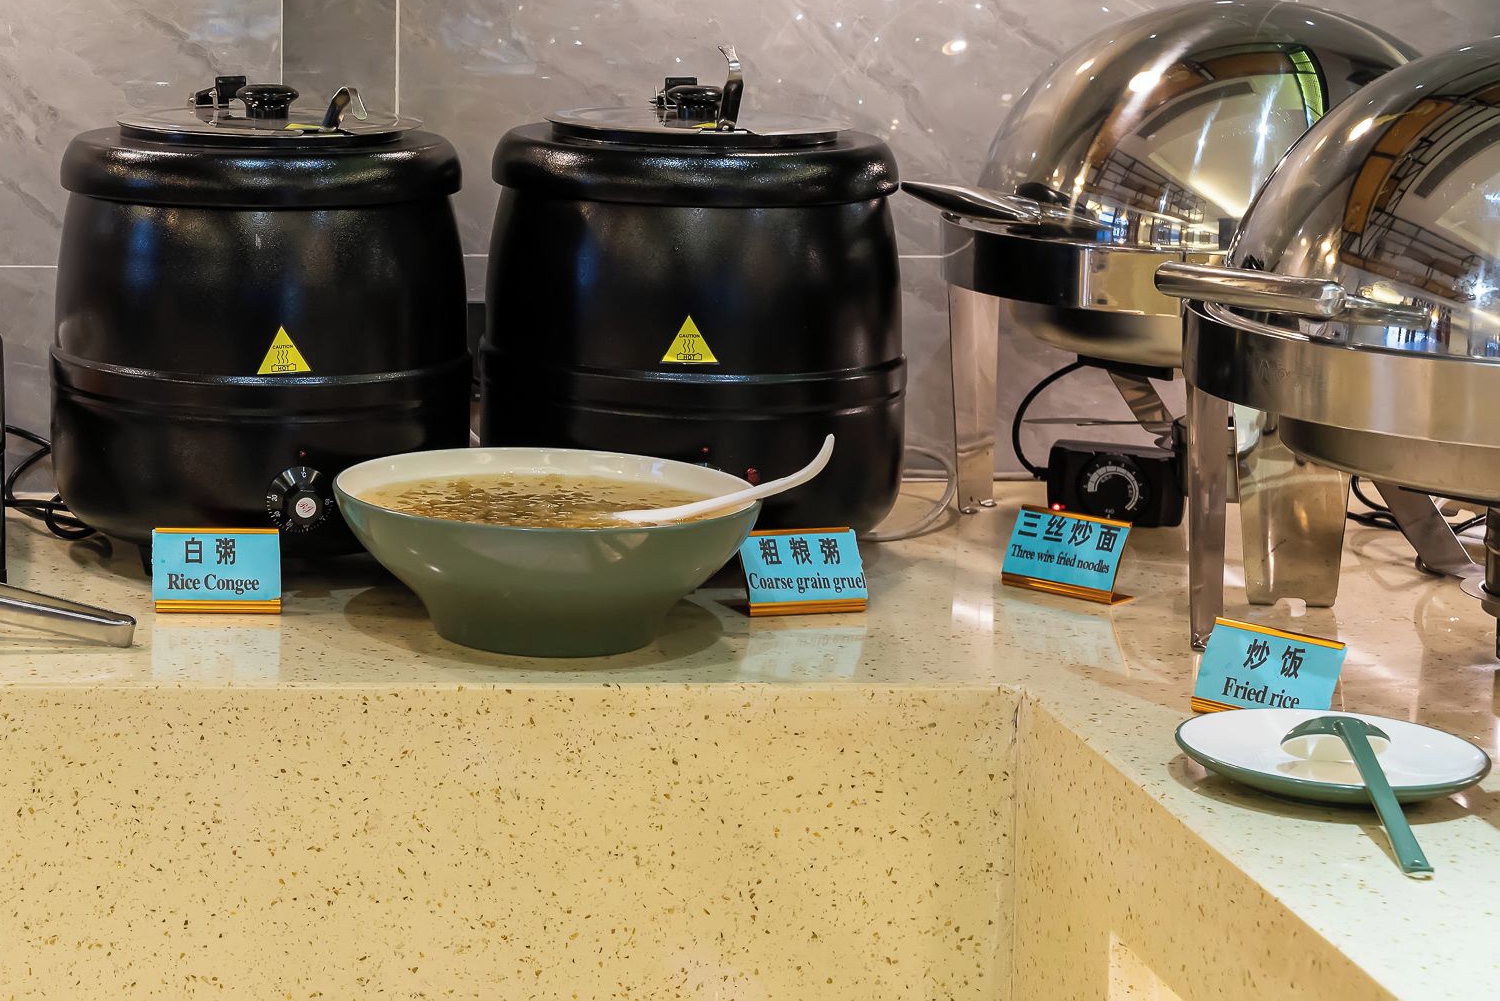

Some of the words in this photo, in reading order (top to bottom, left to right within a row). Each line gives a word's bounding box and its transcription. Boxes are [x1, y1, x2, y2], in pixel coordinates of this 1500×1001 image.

[1018, 512, 1121, 552] 三丝炒面
[185, 537, 236, 565] 白粥
[759, 537, 841, 565] 粗粮粥
[1012, 543, 1035, 560] Three
[1037, 549, 1054, 564] wire
[1056, 551, 1077, 568] fried
[1077, 559, 1110, 574] noodles
[167, 573, 200, 590] Rice
[204, 573, 260, 595] Congee
[748, 573, 794, 590] Coarse
[797, 572, 831, 593] grain
[831, 573, 867, 594] gruel
[1243, 639, 1306, 679] 炒饭
[1222, 676, 1268, 704] Fried
[1268, 689, 1300, 709] rice
